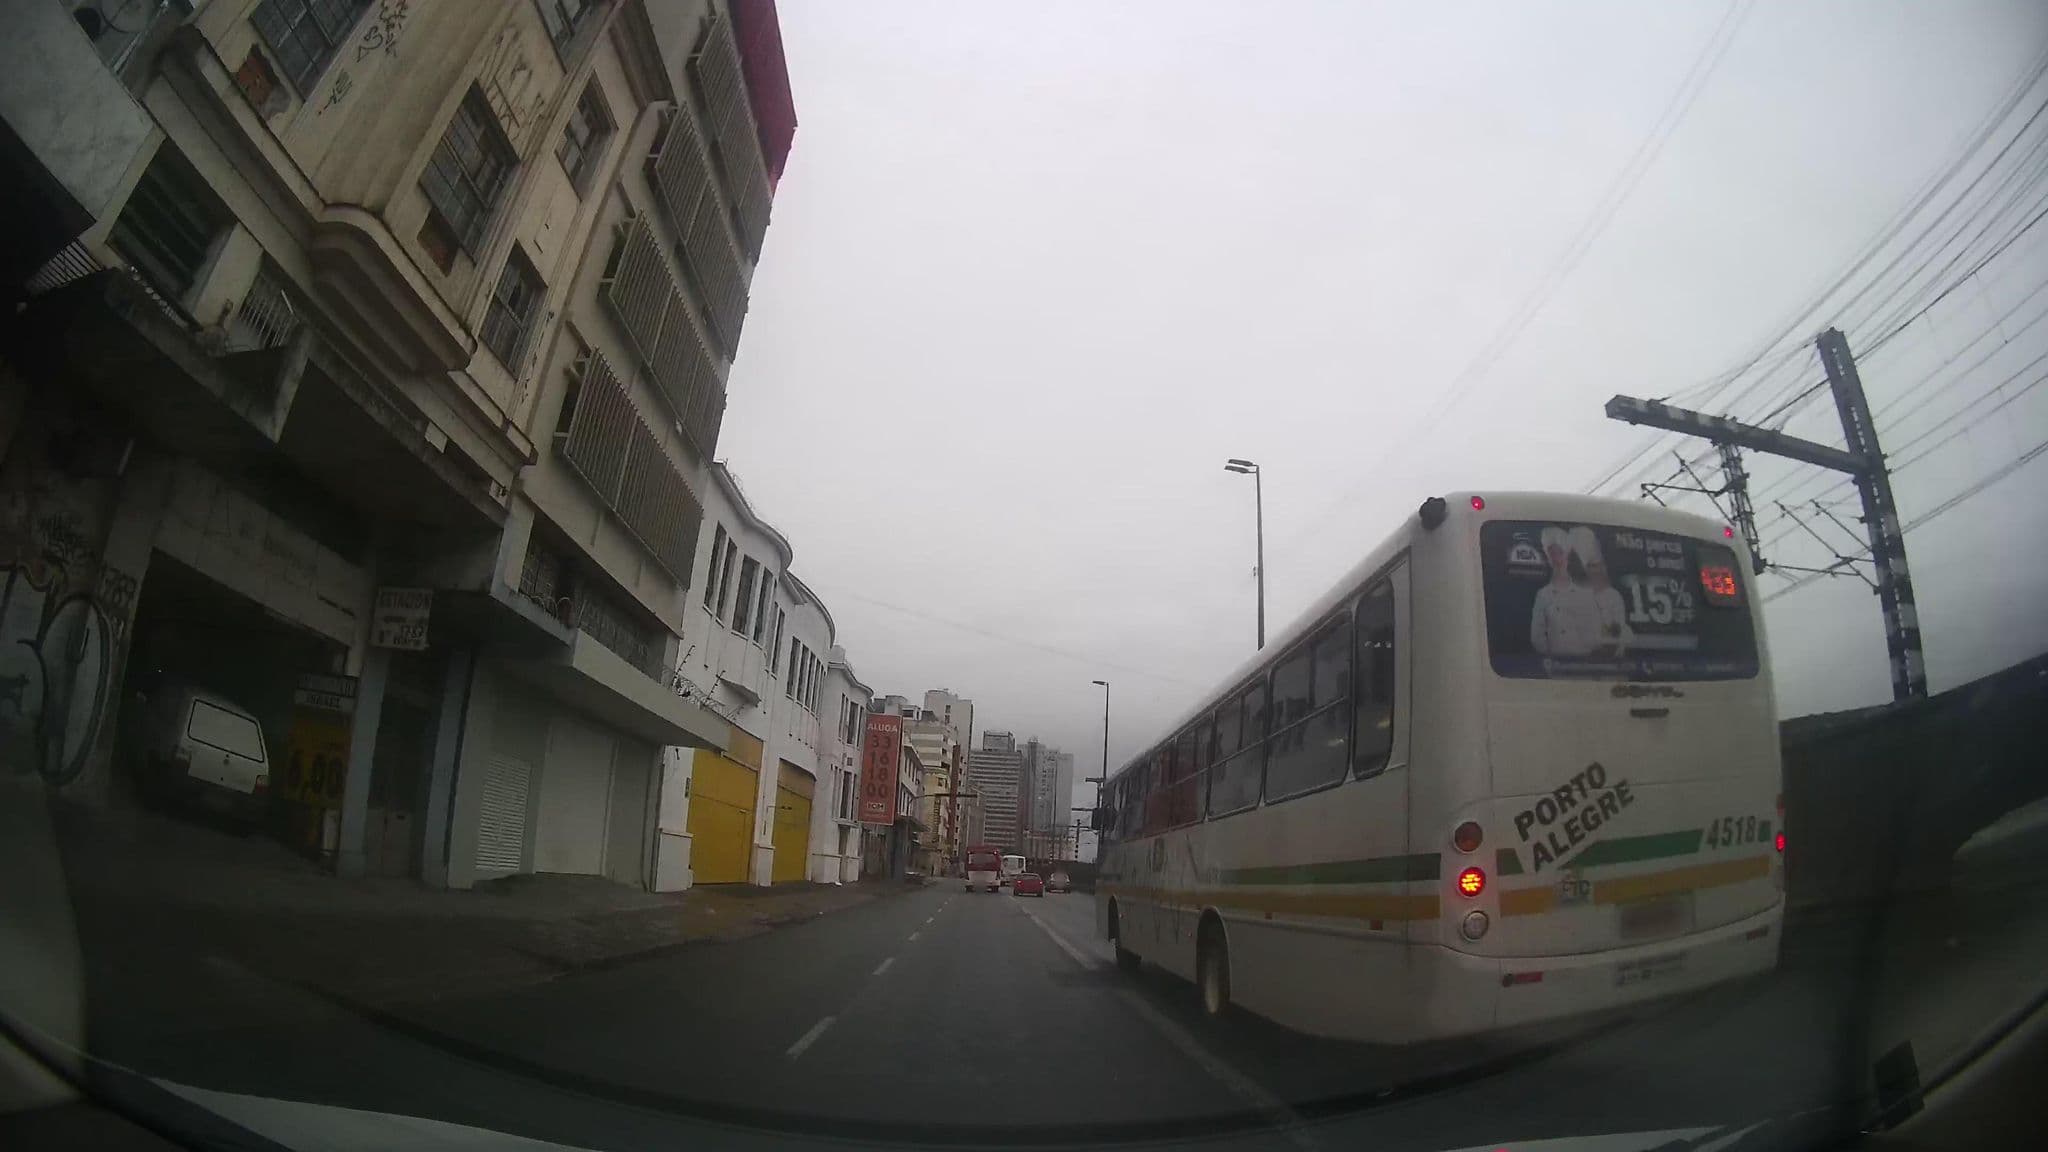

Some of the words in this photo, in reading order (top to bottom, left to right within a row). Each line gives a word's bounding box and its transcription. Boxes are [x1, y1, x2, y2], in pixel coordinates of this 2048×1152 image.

[871, 735, 892, 748] 33
[869, 751, 890, 765] 16
[868, 767, 889, 781] 18
[866, 783, 889, 798] 00
[1514, 761, 1607, 842] PORTO
[1531, 780, 1635, 873] ALEGRE
[1706, 816, 1756, 850] 4518
